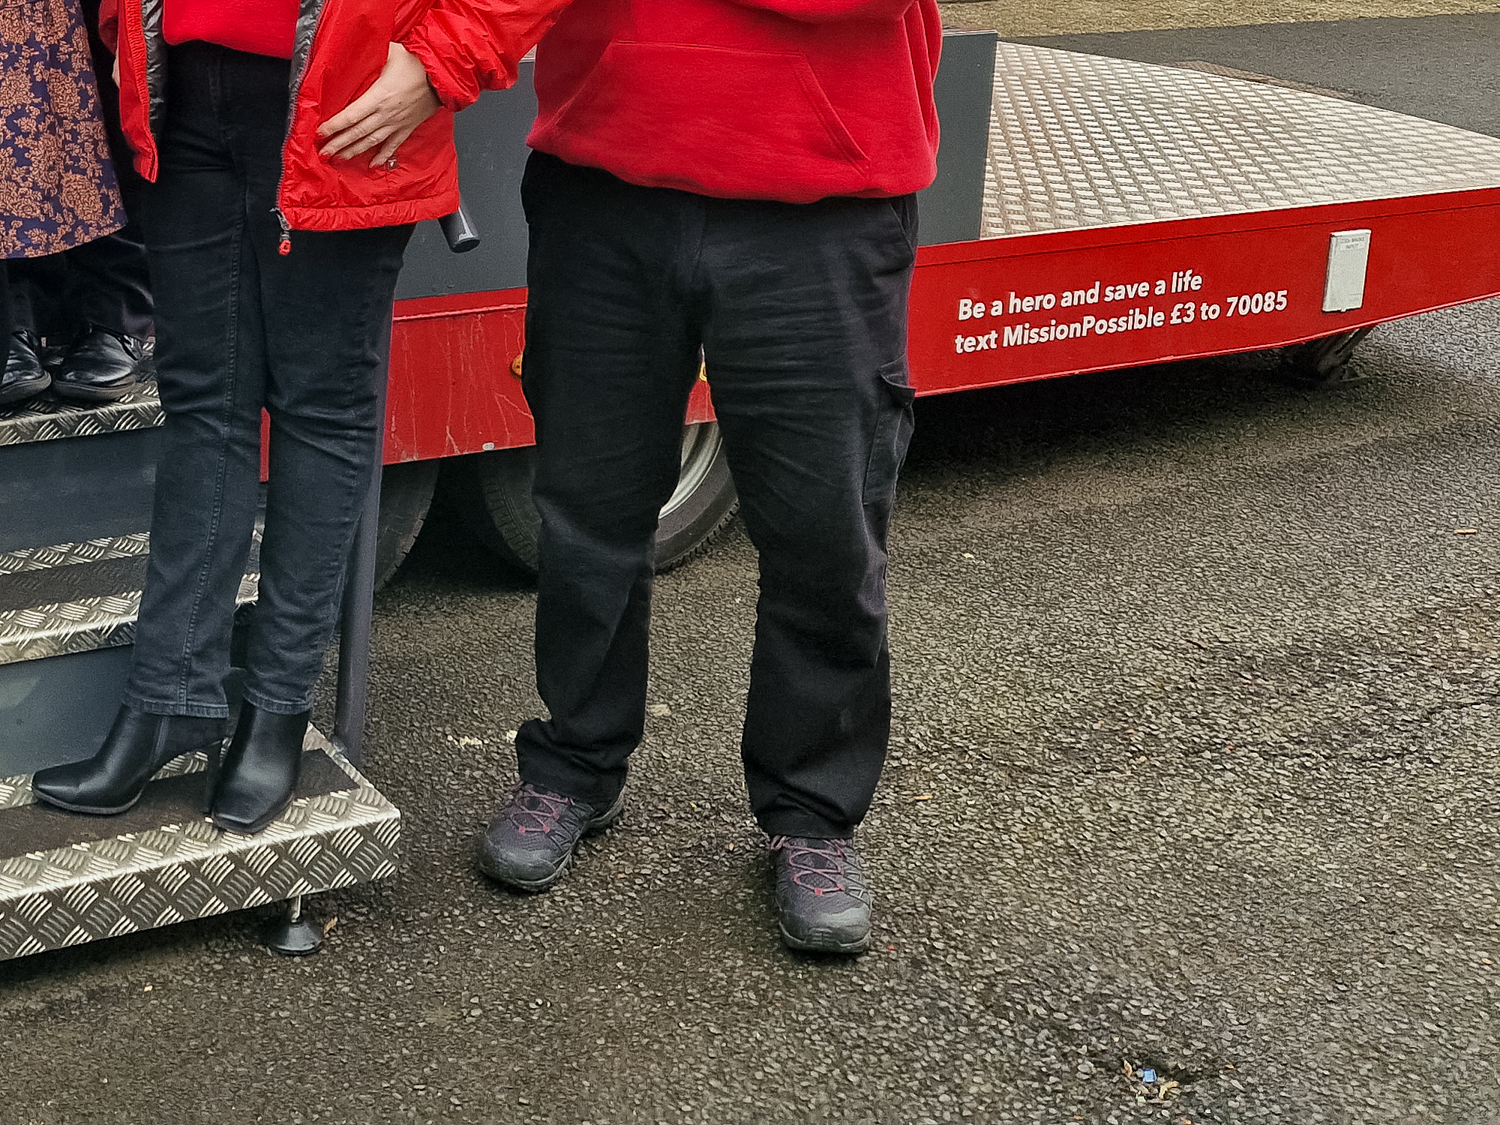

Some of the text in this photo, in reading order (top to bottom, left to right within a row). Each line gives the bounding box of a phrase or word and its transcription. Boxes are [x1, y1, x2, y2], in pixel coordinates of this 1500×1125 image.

[954, 289, 1288, 354] text MissionPossible £3 to 70085
[958, 268, 1203, 321] Be a hero and save a life
